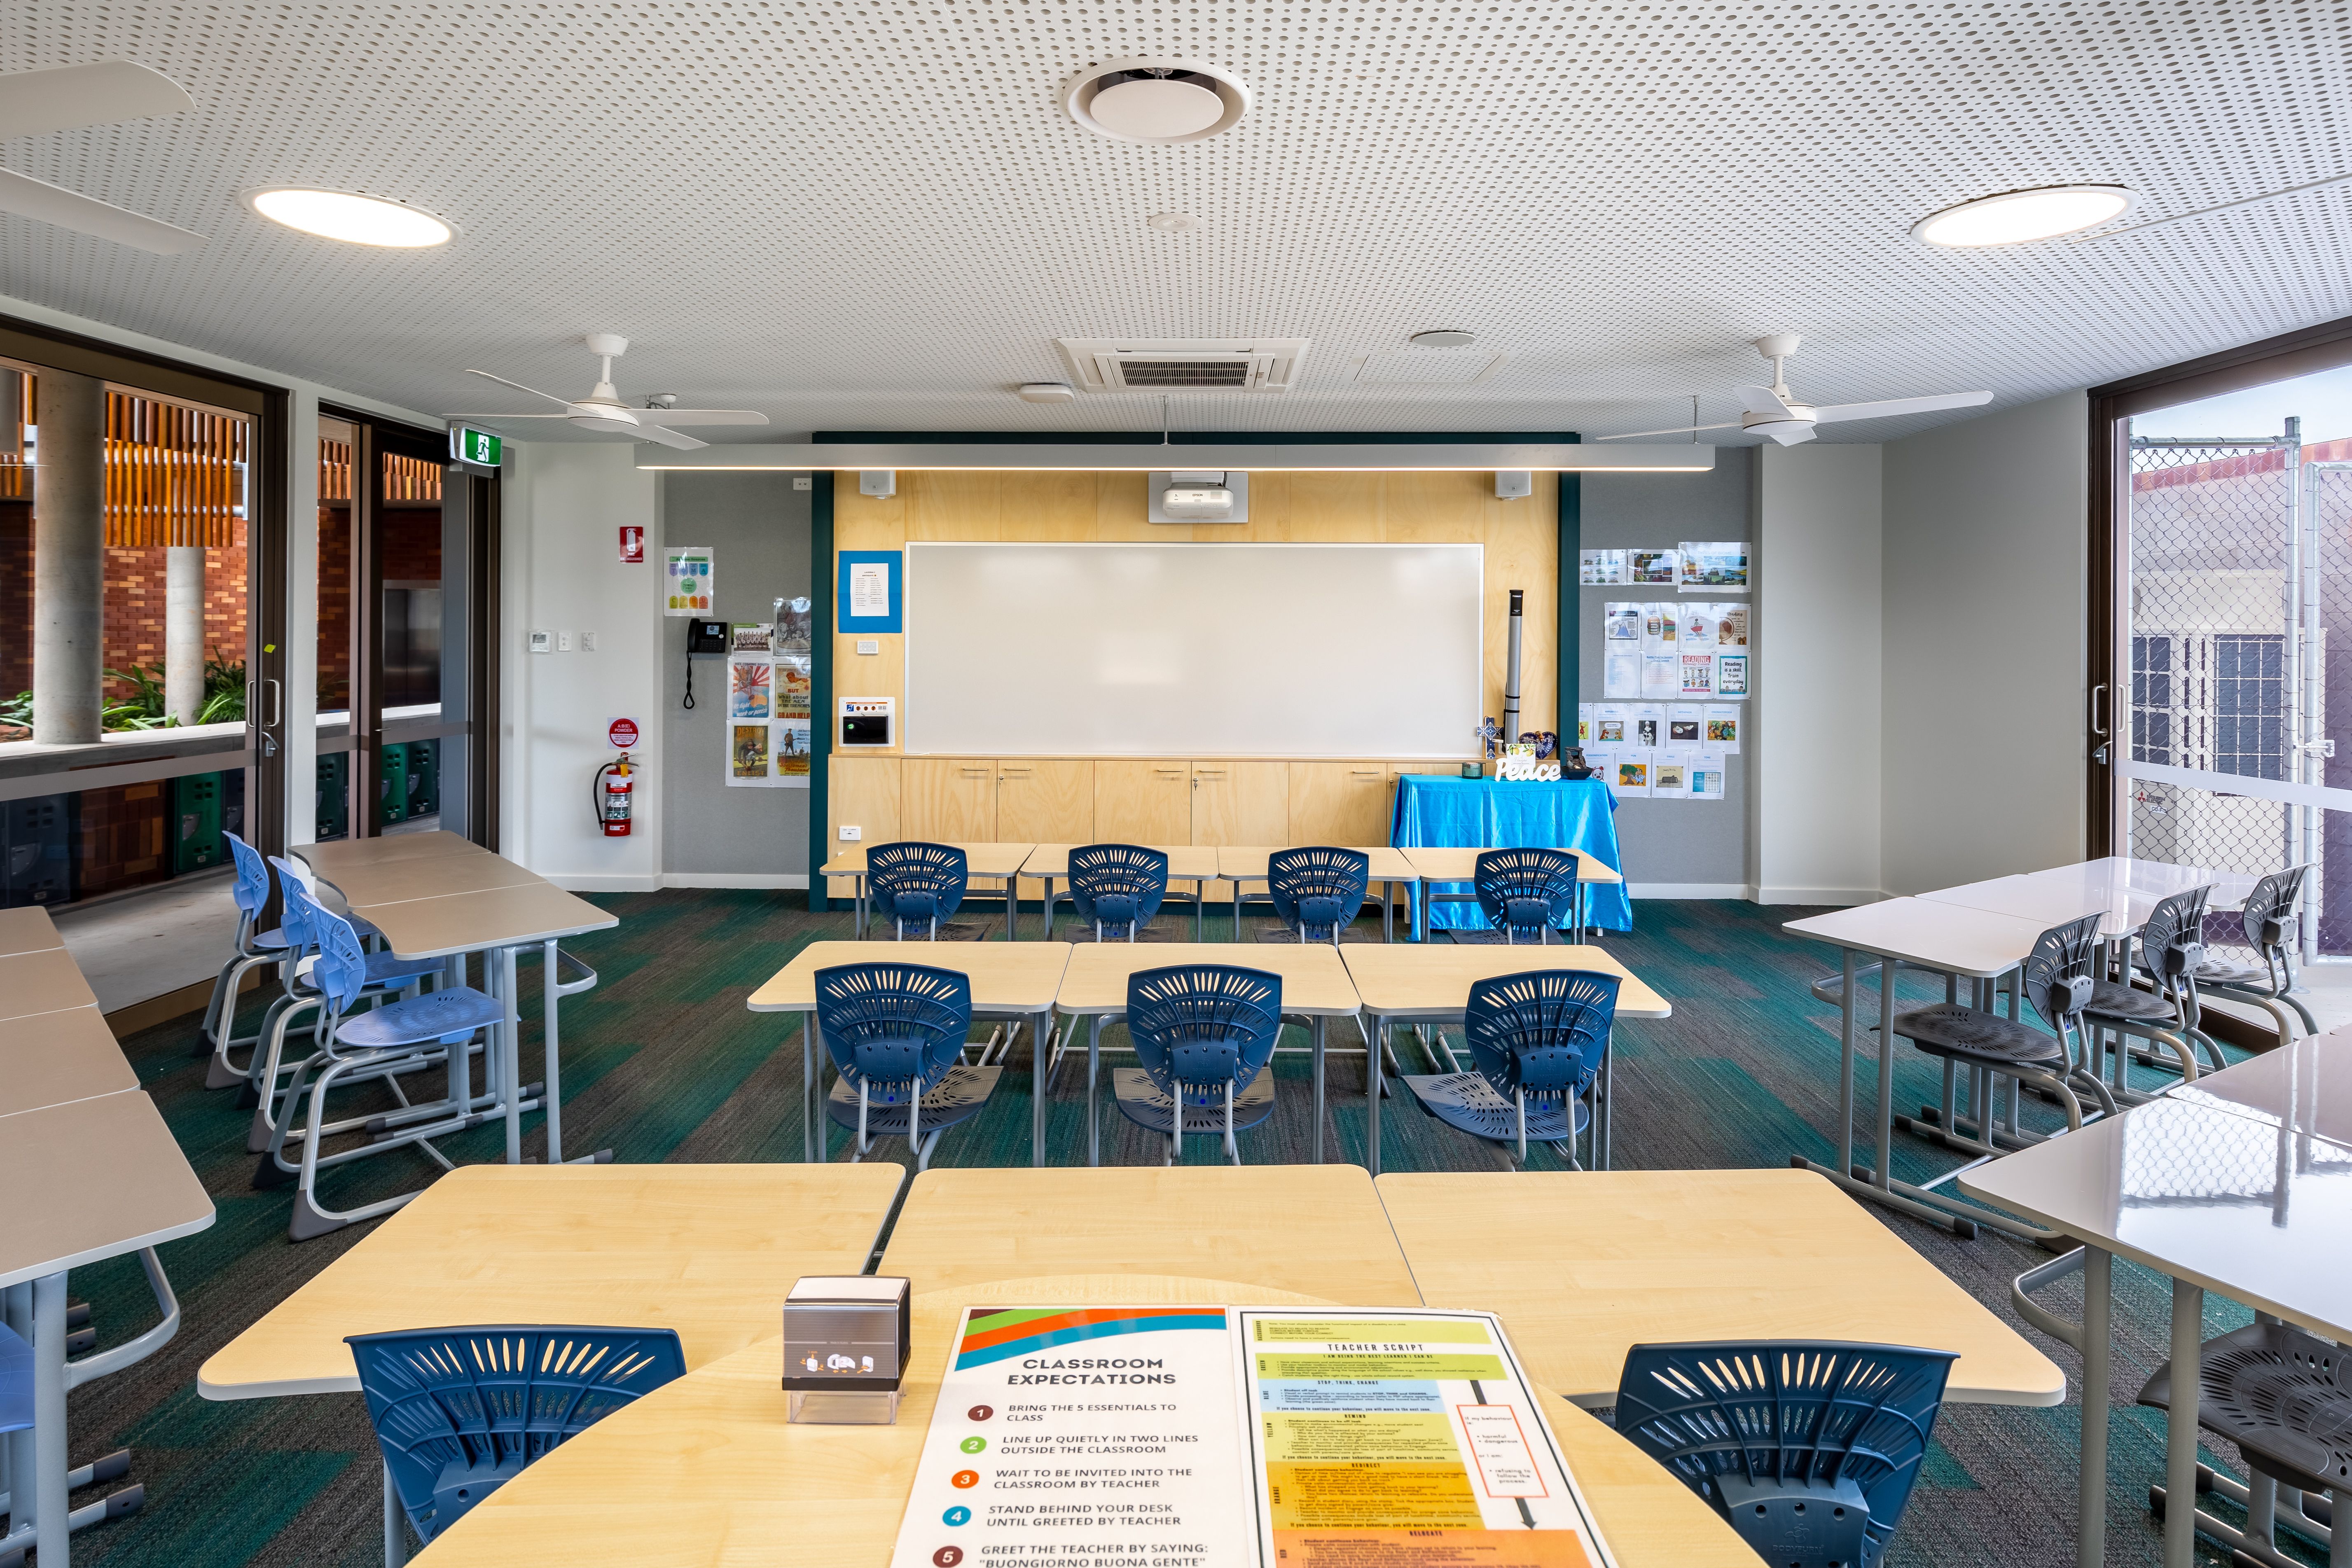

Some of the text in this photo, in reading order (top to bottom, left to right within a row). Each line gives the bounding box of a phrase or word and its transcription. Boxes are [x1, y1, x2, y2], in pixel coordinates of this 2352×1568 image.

[737, 727, 765, 736] DESTROY
[1495, 758, 1562, 782] Peace
[1023, 1359, 1162, 1369] CLASSROOM
[1008, 1374, 1176, 1385] EXPECTATIONS
[977, 1409, 984, 1417] 1
[1056, 1436, 1109, 1444] QUIETLY
[968, 1441, 978, 1450] 2
[960, 1475, 970, 1484] 3
[989, 1505, 1034, 1514] STAND
[1039, 1505, 1092, 1513] BEHIND
[951, 1511, 962, 1521] 4
[987, 1518, 1028, 1526] UNTIL
[1033, 1517, 1093, 1526] GREETED
[1120, 1517, 1181, 1525] TEACHER
[982, 1544, 1208, 1554] GREET THE TEACHER BY SAYING:
[942, 1551, 954, 1563] 5
[980, 1558, 1205, 1568] "BUONGIORNO BUONA GENTE"
